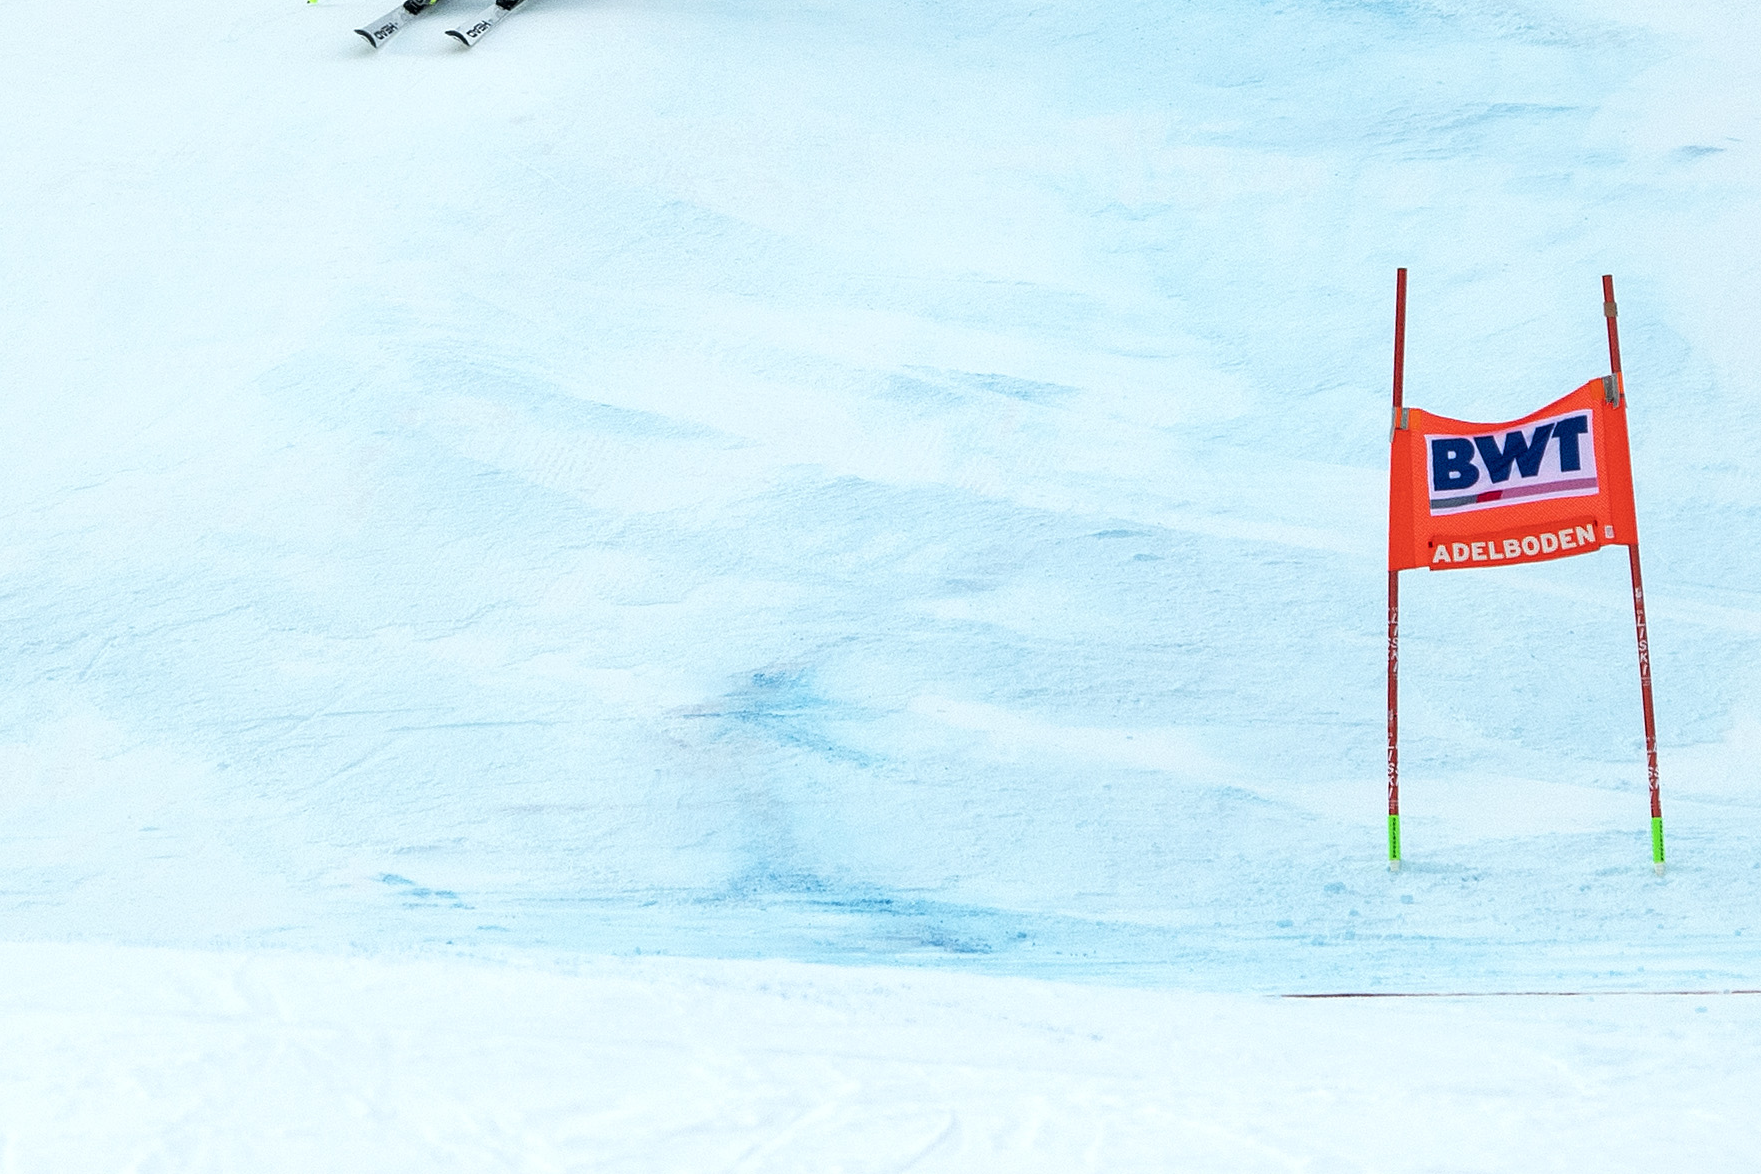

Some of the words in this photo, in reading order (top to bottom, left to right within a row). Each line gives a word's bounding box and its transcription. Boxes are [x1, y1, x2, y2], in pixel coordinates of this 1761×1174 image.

[374, 22, 398, 40] HEAD
[466, 20, 491, 38] HEAD
[1431, 415, 1588, 491] BWT
[1433, 524, 1596, 563] ADELBODEN
[1637, 615, 1648, 676] LISKI
